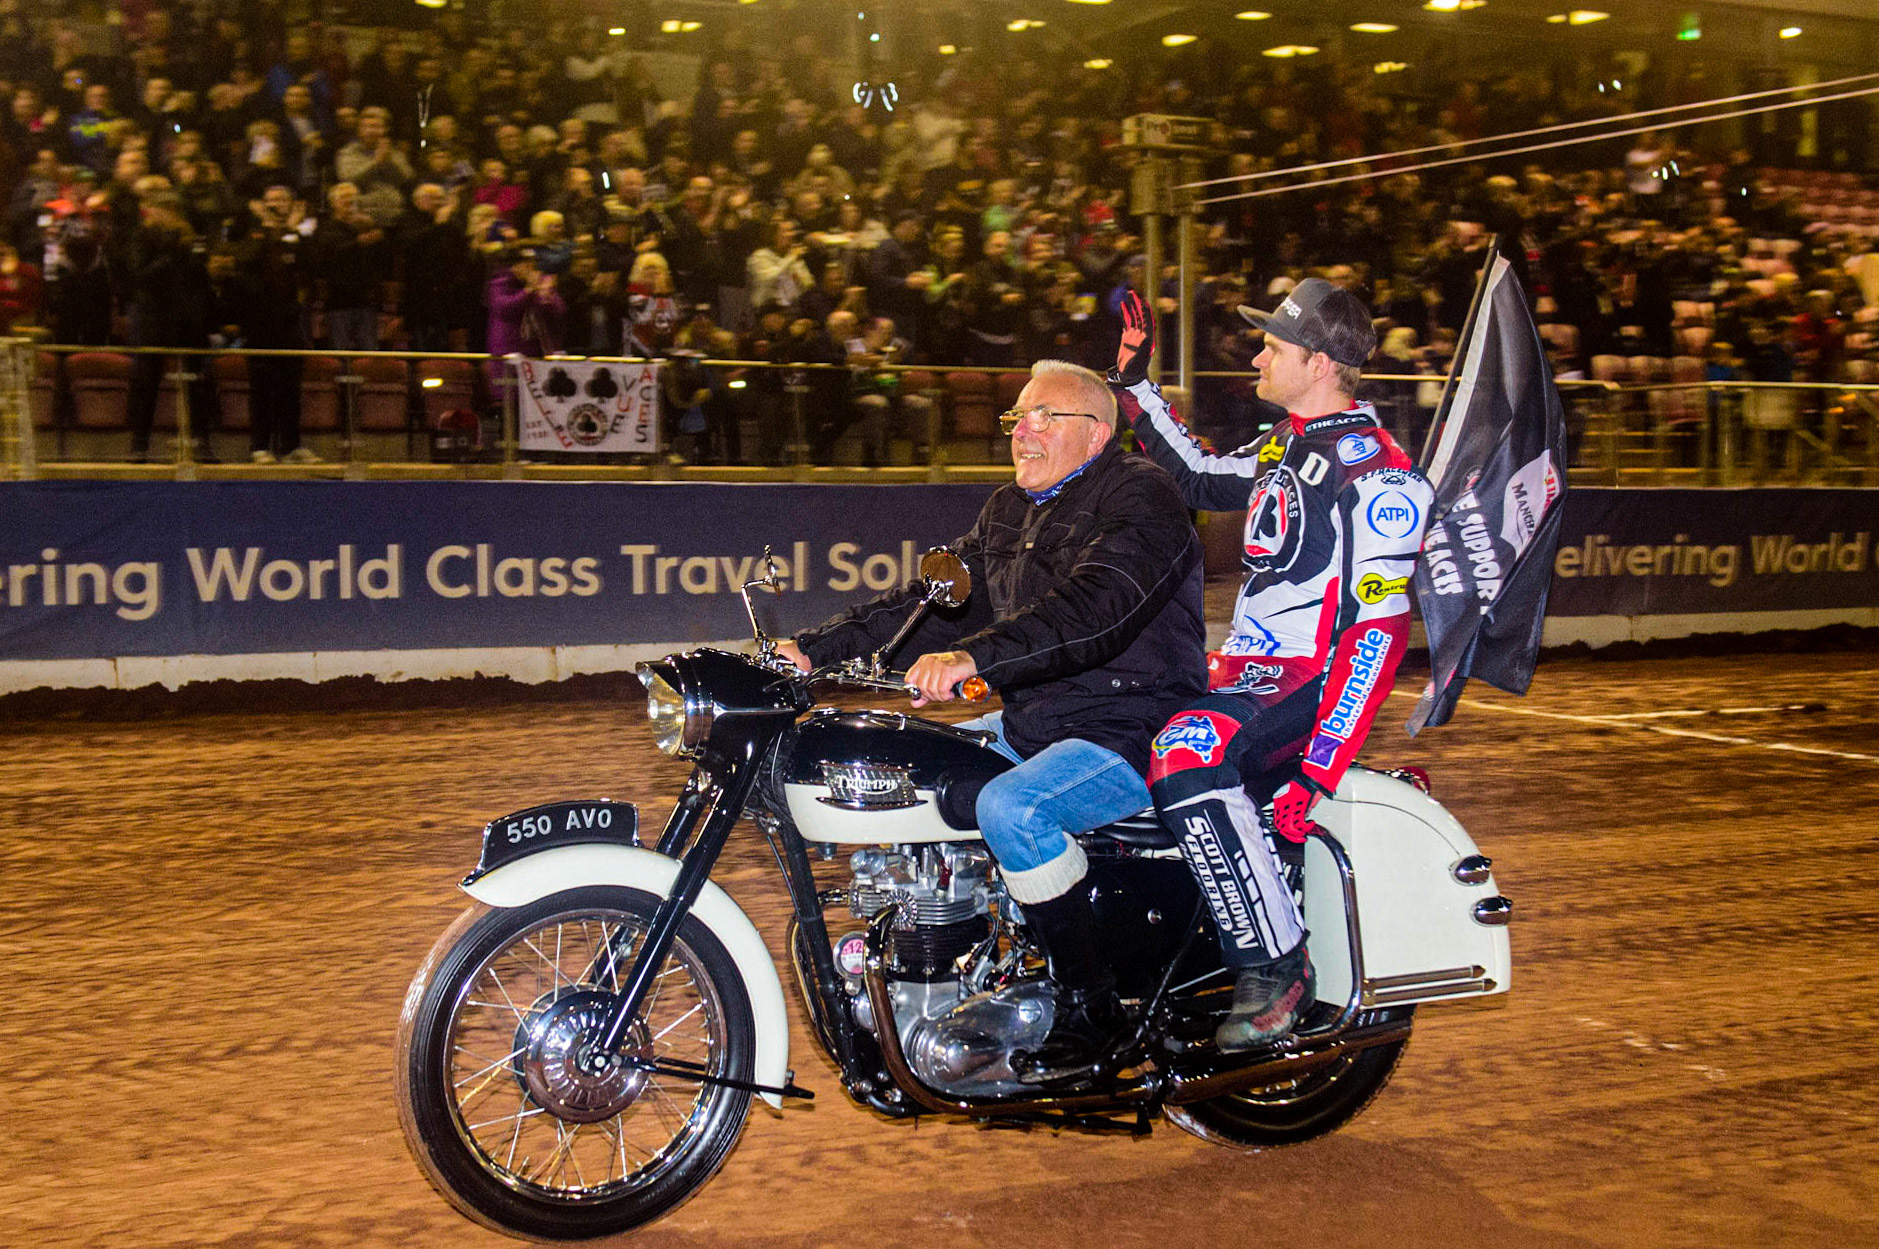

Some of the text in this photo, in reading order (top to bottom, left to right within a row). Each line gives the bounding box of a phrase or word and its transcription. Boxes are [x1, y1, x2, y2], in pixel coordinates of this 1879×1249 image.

[609, 374, 637, 434] VUE
[634, 366, 656, 443] ACES
[1376, 507, 1409, 521] ATPI
[0, 540, 924, 621] ring World Class Travel Sol
[1456, 512, 1503, 616] SUPPOR
[1750, 531, 1870, 575] World
[1322, 629, 1385, 735] burnside
[835, 774, 898, 794] TRIUMPH
[507, 815, 552, 844] 550
[1184, 816, 1231, 877] SCOTT
[1219, 879, 1259, 950] BROWN
[1187, 838, 1231, 927] FLOORING
